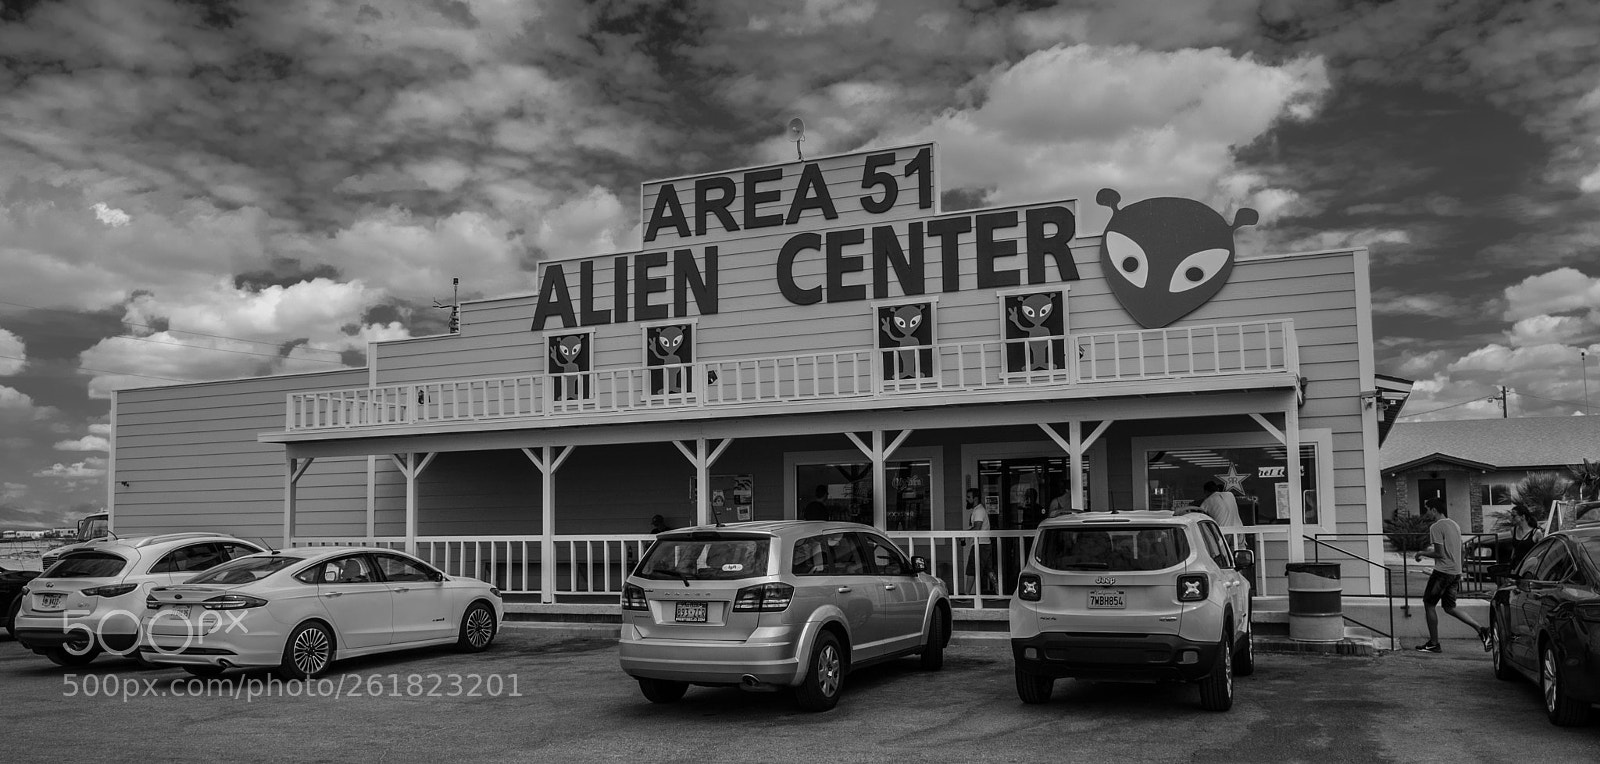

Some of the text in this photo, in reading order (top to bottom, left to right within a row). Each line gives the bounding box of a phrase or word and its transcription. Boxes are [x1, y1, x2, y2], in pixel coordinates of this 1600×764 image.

[645, 147, 932, 241] AREA 51
[532, 205, 1081, 331] ALIEN CENTER
[1090, 595, 1124, 606] 7WBH854
[1095, 576, 1116, 586] Jeep
